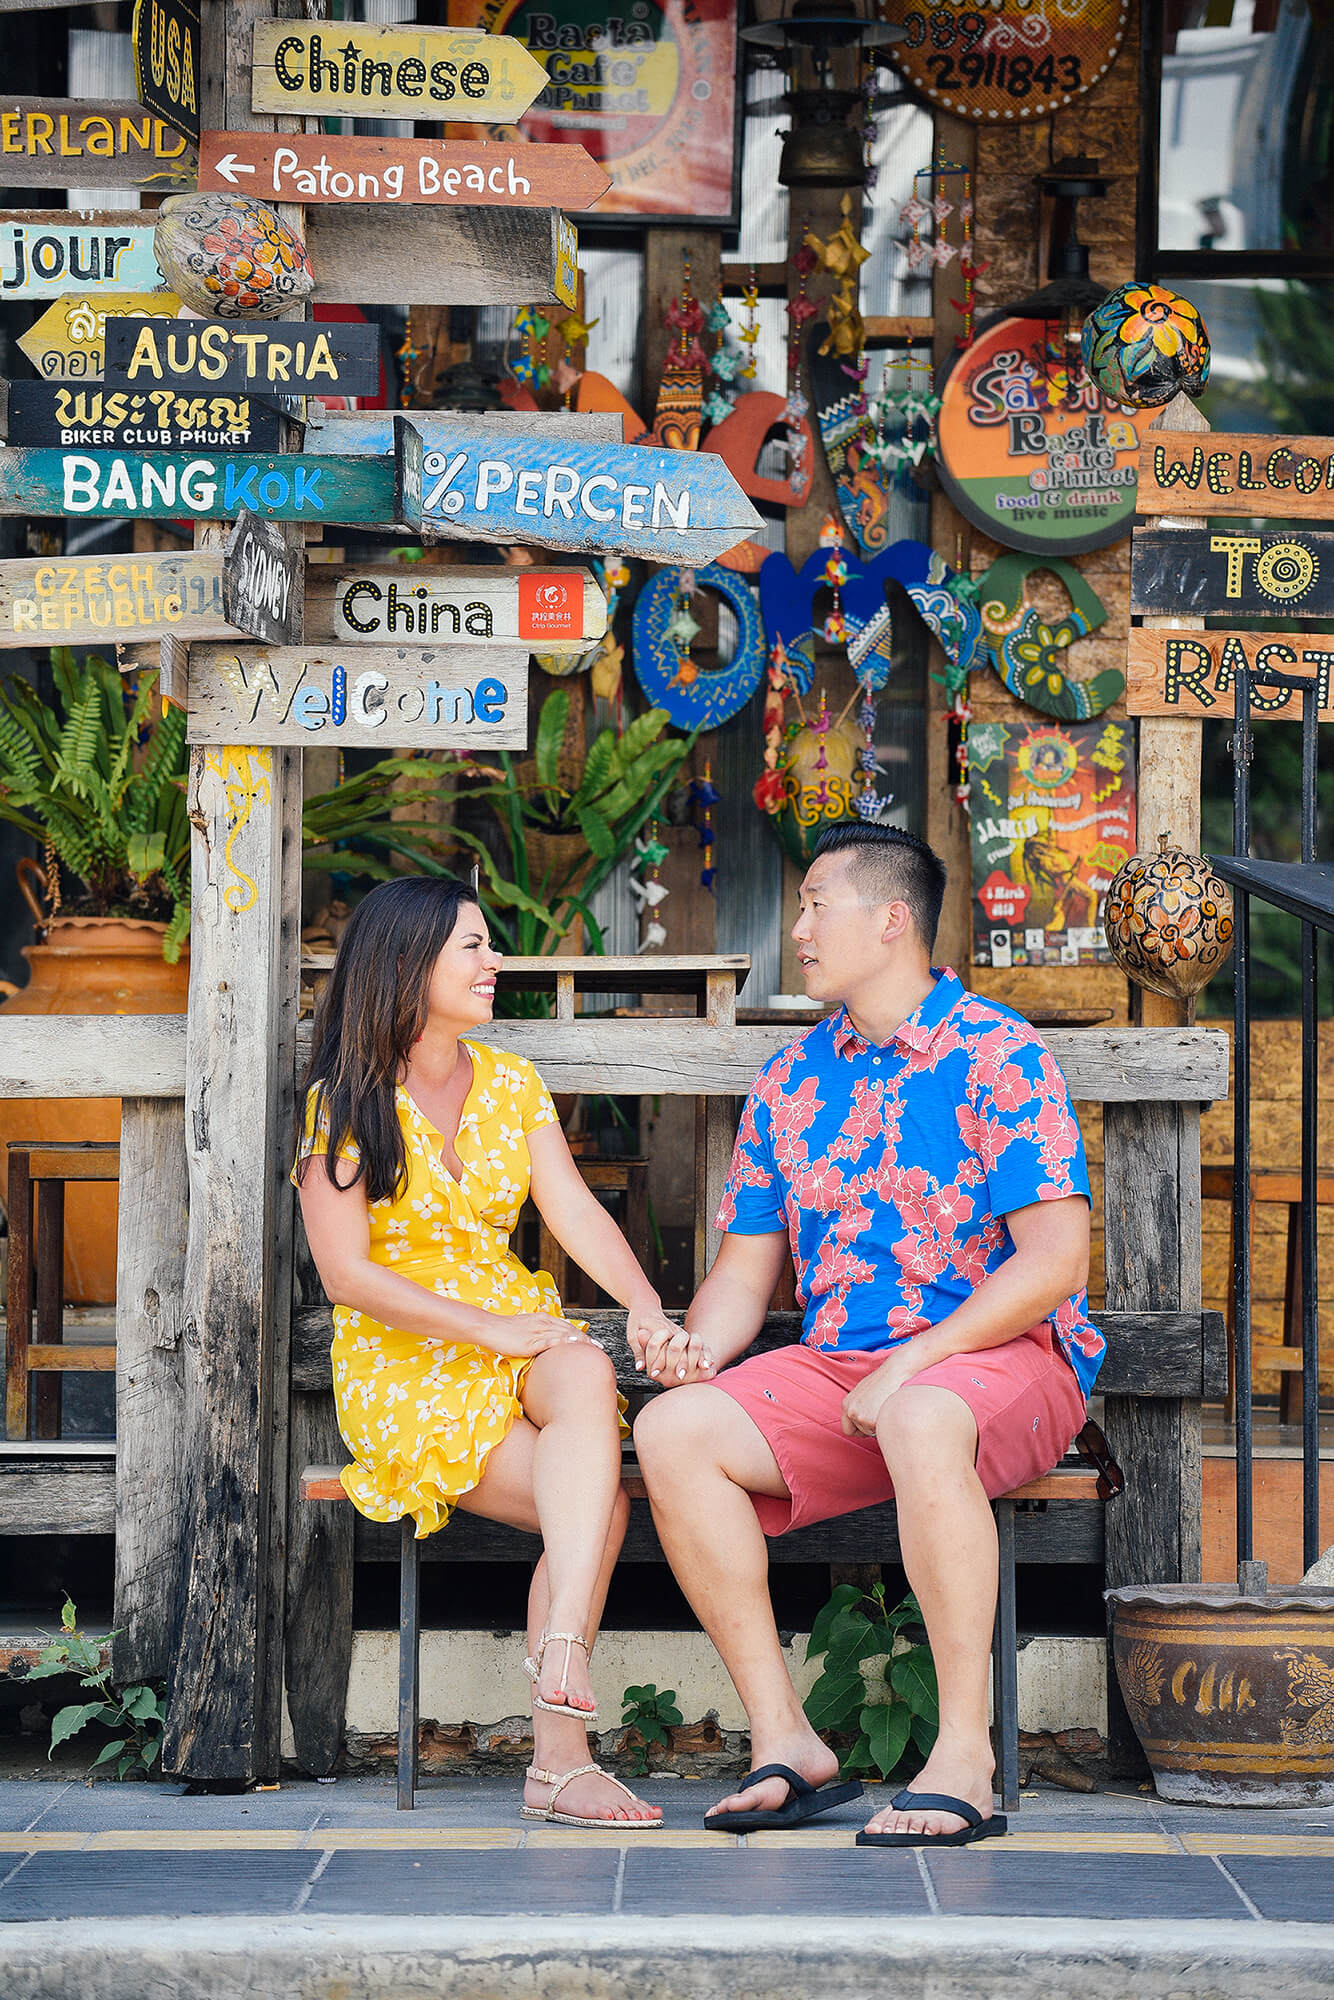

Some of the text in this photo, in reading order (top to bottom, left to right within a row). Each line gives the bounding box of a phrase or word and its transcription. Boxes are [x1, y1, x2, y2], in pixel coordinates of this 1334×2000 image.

[526, 13, 657, 51] Rasta
[902, 11, 986, 52] 089
[150, 0, 196, 115] USA
[274, 34, 491, 101] Chinese
[926, 53, 1083, 98] 2911843
[272, 147, 532, 200] Patong Beach
[1, 227, 132, 290] jour
[127, 325, 340, 382] AUSTRIA
[60, 428, 251, 445] BIKER CLUB PHUKET
[1008, 413, 1140, 456] Rasta
[62, 455, 325, 512] BANGKOK
[1153, 445, 1334, 495] WELCO
[996, 488, 1122, 509] food & drink
[1012, 504, 1109, 522] live music
[34, 564, 153, 597] CZECH
[237, 530, 292, 625] SYDNEY
[1210, 534, 1322, 606] TO
[13, 593, 184, 633] REPUBLIC
[342, 580, 494, 638] China
